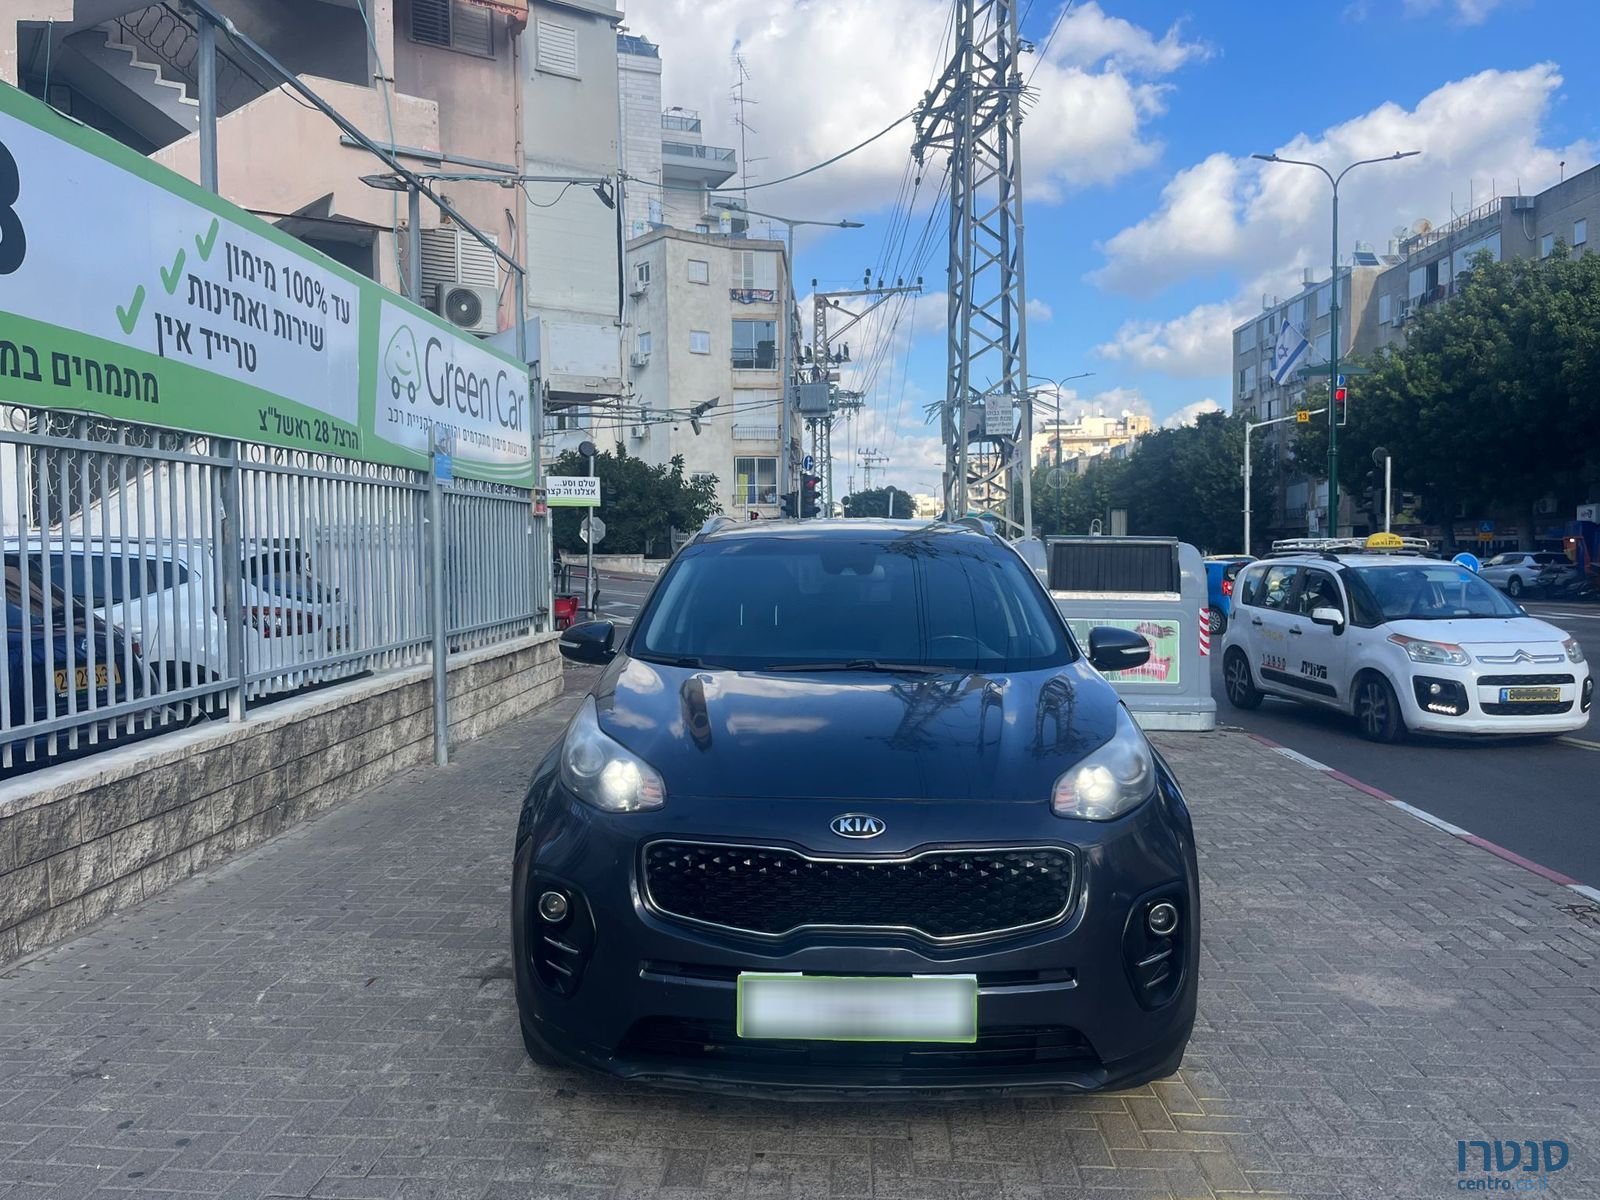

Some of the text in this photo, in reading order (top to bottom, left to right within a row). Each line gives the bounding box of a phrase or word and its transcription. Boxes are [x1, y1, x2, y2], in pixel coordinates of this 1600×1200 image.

[225, 241, 350, 324] עד 100% מימון
[187, 273, 324, 351] שירות ואמינות
[154, 312, 257, 372] טרייד אין
[52, 351, 159, 404] מתמחים
[425, 336, 524, 432] Green Car
[388, 407, 404, 425] רכב
[314, 418, 329, 444] 28
[332, 421, 358, 450] הרצל
[574, 488, 596, 496] אצלנו
[578, 480, 596, 488] שלם
[840, 818, 877, 832] KIA
